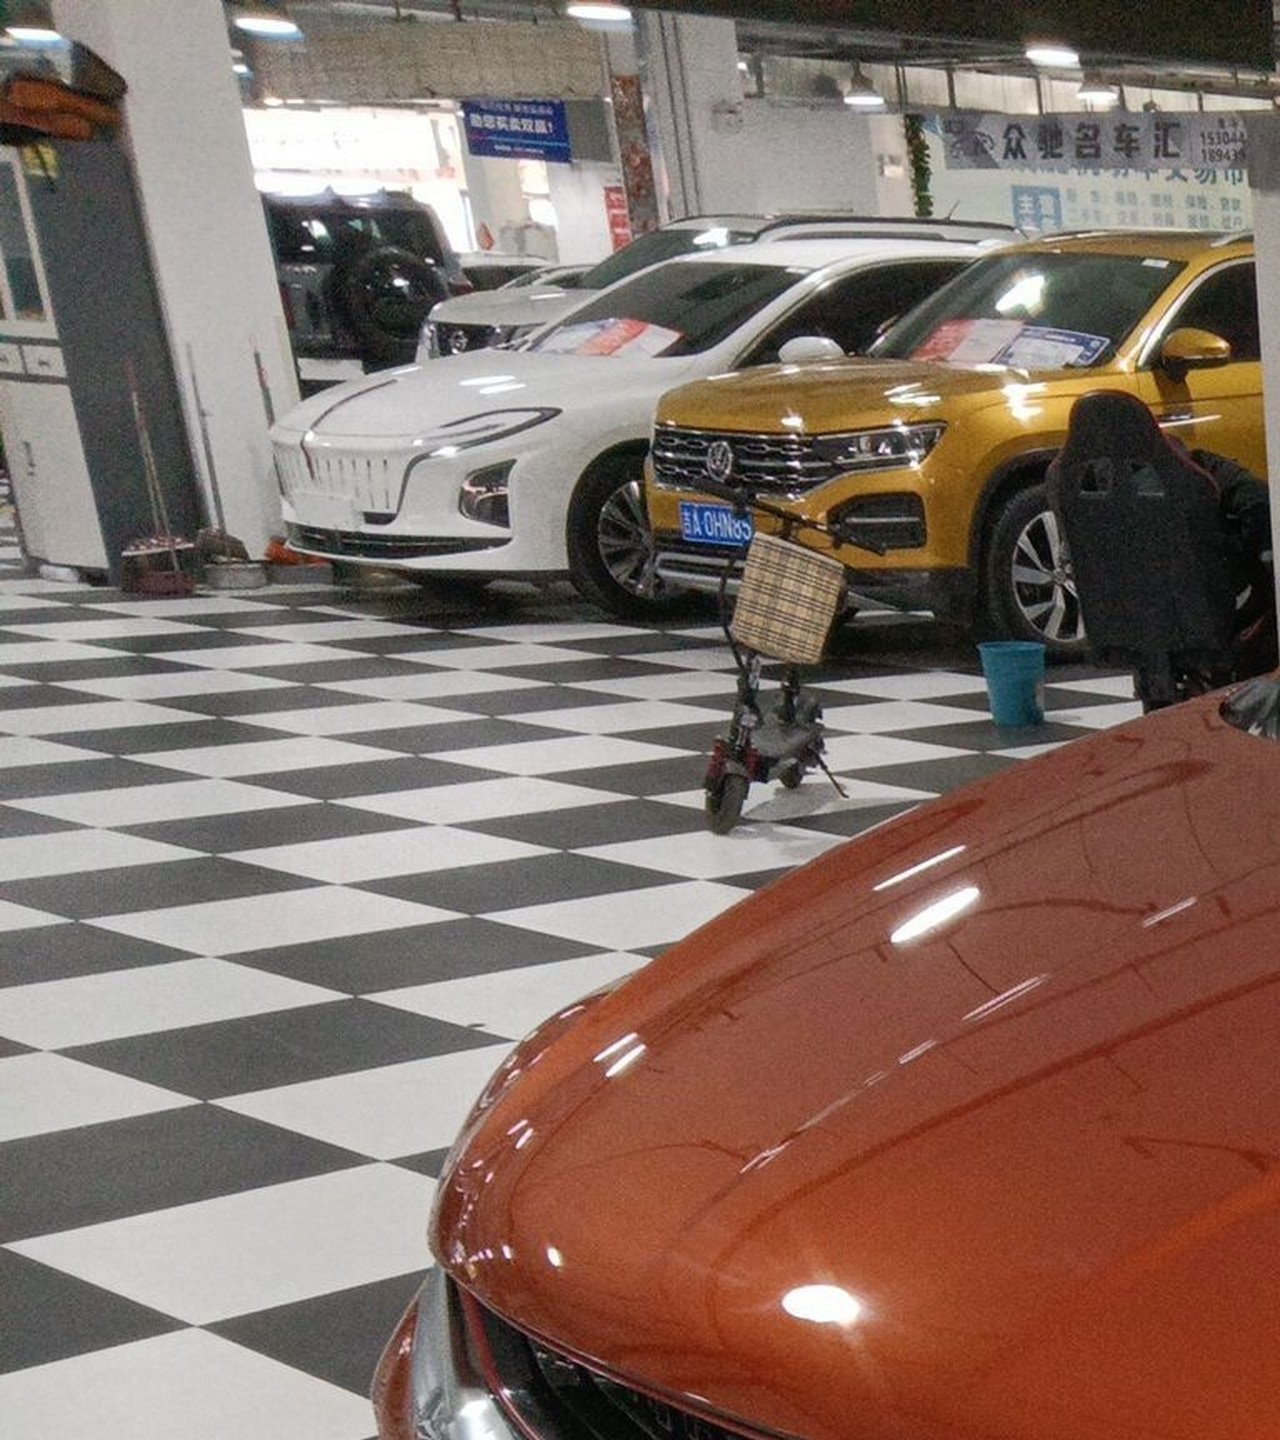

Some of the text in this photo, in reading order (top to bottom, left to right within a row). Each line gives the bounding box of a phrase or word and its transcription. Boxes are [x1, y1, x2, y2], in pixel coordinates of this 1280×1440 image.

[1002, 121, 1181, 161] 众驰名车汇
